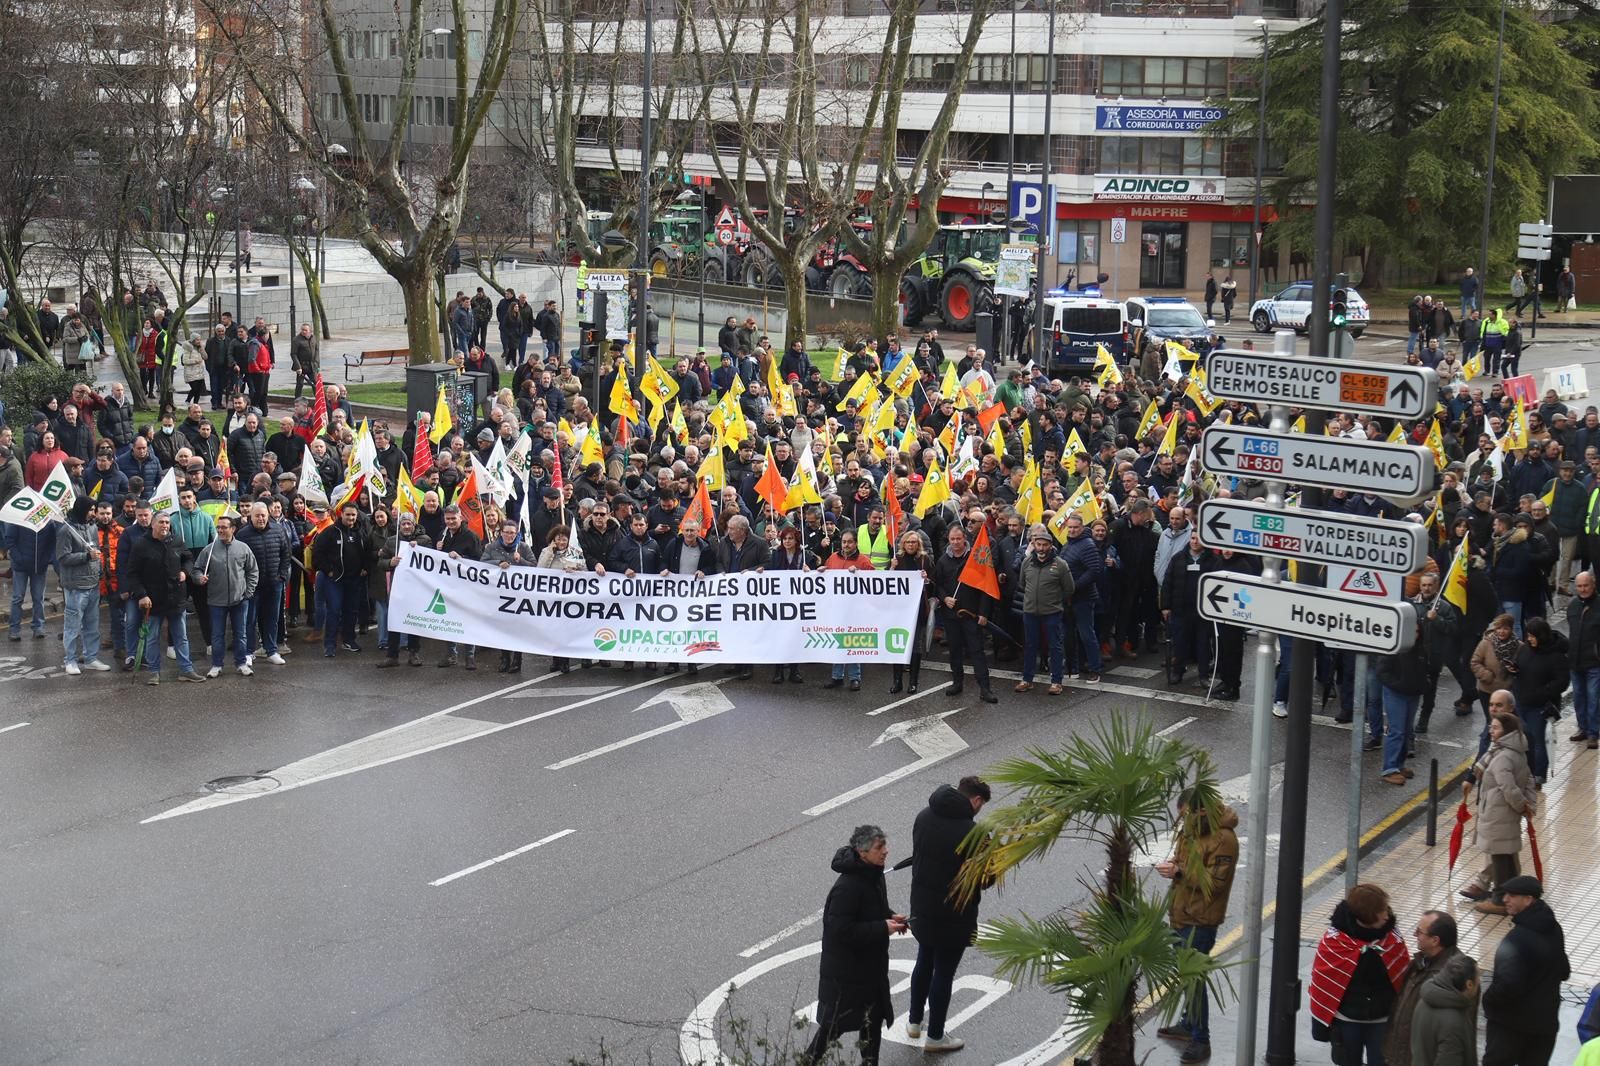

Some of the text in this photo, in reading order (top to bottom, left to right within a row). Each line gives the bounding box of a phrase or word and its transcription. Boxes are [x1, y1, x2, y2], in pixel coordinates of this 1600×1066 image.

[1126, 108, 1222, 120] ASESORÍA MIELGO
[1126, 120, 1173, 129] CORREDURÍA
[1104, 179, 1190, 192] ADINCO
[1019, 187, 1042, 220] P
[1131, 207, 1188, 218] MAPFRE
[722, 232, 730, 240] 20
[1214, 359, 1336, 385] FUENTESAUCO
[1213, 376, 1320, 400] FERMOSELLE
[1342, 374, 1386, 389] CL-605
[1342, 390, 1384, 404] CL-527
[1244, 440, 1278, 454] A-66
[1238, 454, 1282, 472] N-630
[1292, 452, 1414, 480] SALAMANCA
[1254, 516, 1284, 530] E-82
[1234, 530, 1300, 550] A-11 N-122
[1306, 524, 1408, 548] TORDESILLAS
[1304, 539, 1408, 566] VALLADOLID
[409, 551, 910, 598] NO A LOS ACUERDOS COMERCIALES QUE NOS HUNDEN
[498, 596, 816, 622] ZAMORA NO SE RINDE
[1232, 609, 1252, 620] Sacyl
[440, 618, 462, 627] Agraria
[1291, 604, 1394, 639] Hospitales
[428, 624, 464, 634] Agricultores
[619, 629, 717, 645] UPA COAG
[843, 635, 875, 648] UCCL
[619, 646, 678, 654] ALIANZA
